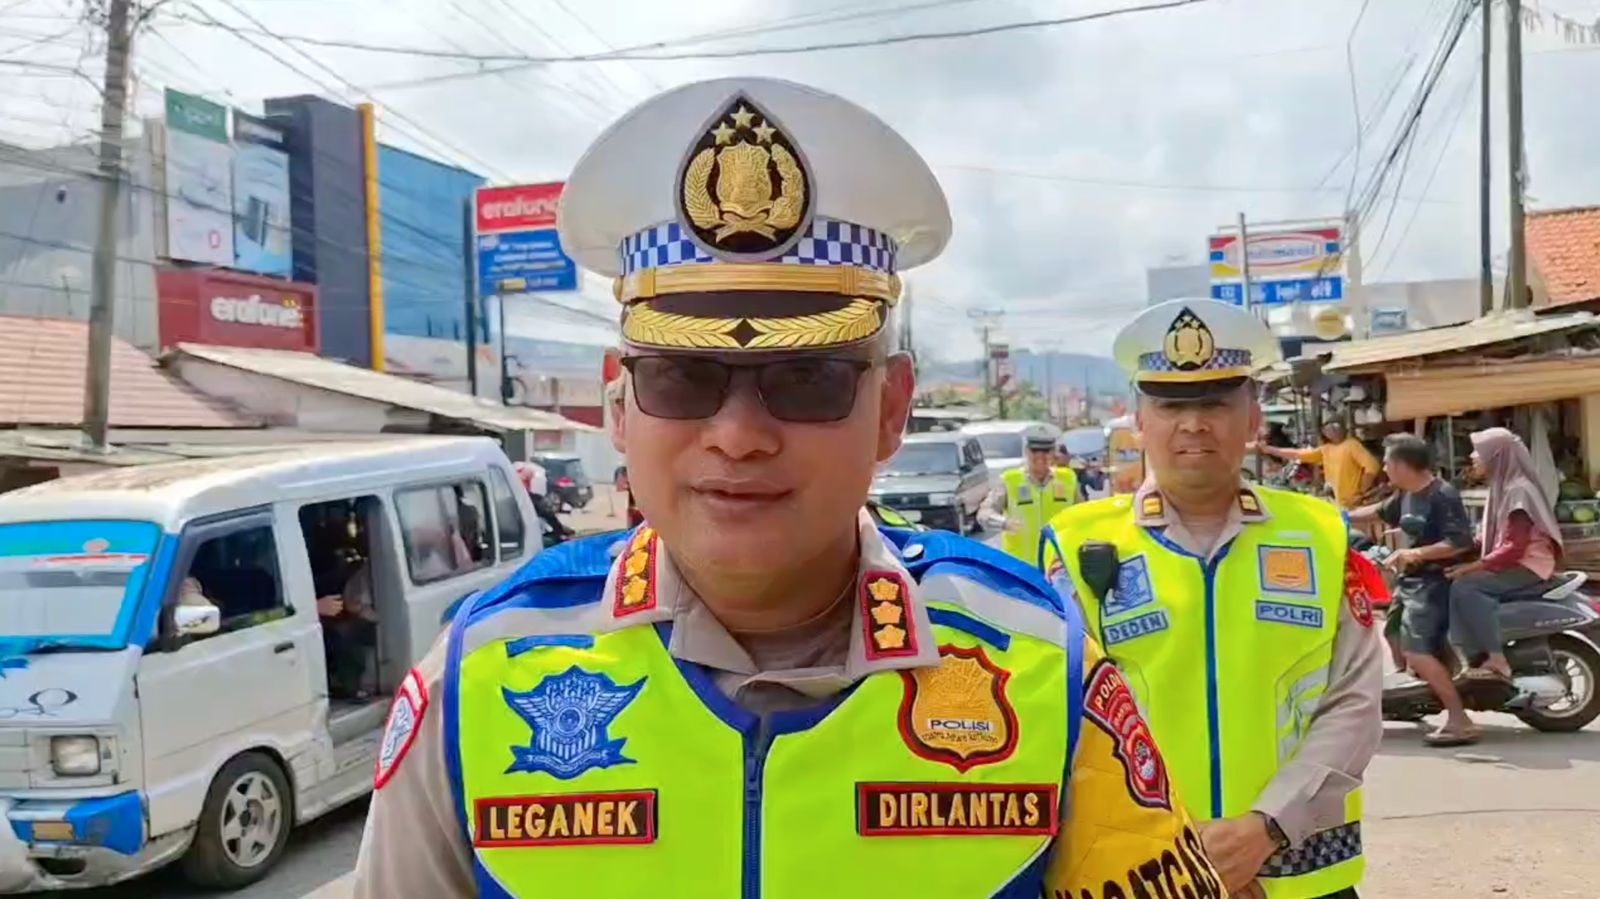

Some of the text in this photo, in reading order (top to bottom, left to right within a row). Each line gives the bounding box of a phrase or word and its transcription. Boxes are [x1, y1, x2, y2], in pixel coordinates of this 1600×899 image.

[211, 294, 301, 328] erafone
[1108, 614, 1162, 640] DEDEN
[1259, 605, 1319, 623] POLRI
[930, 719, 990, 731] POLISI
[489, 801, 639, 839] LEGANEK
[878, 792, 1041, 827] DIRLANTAS
